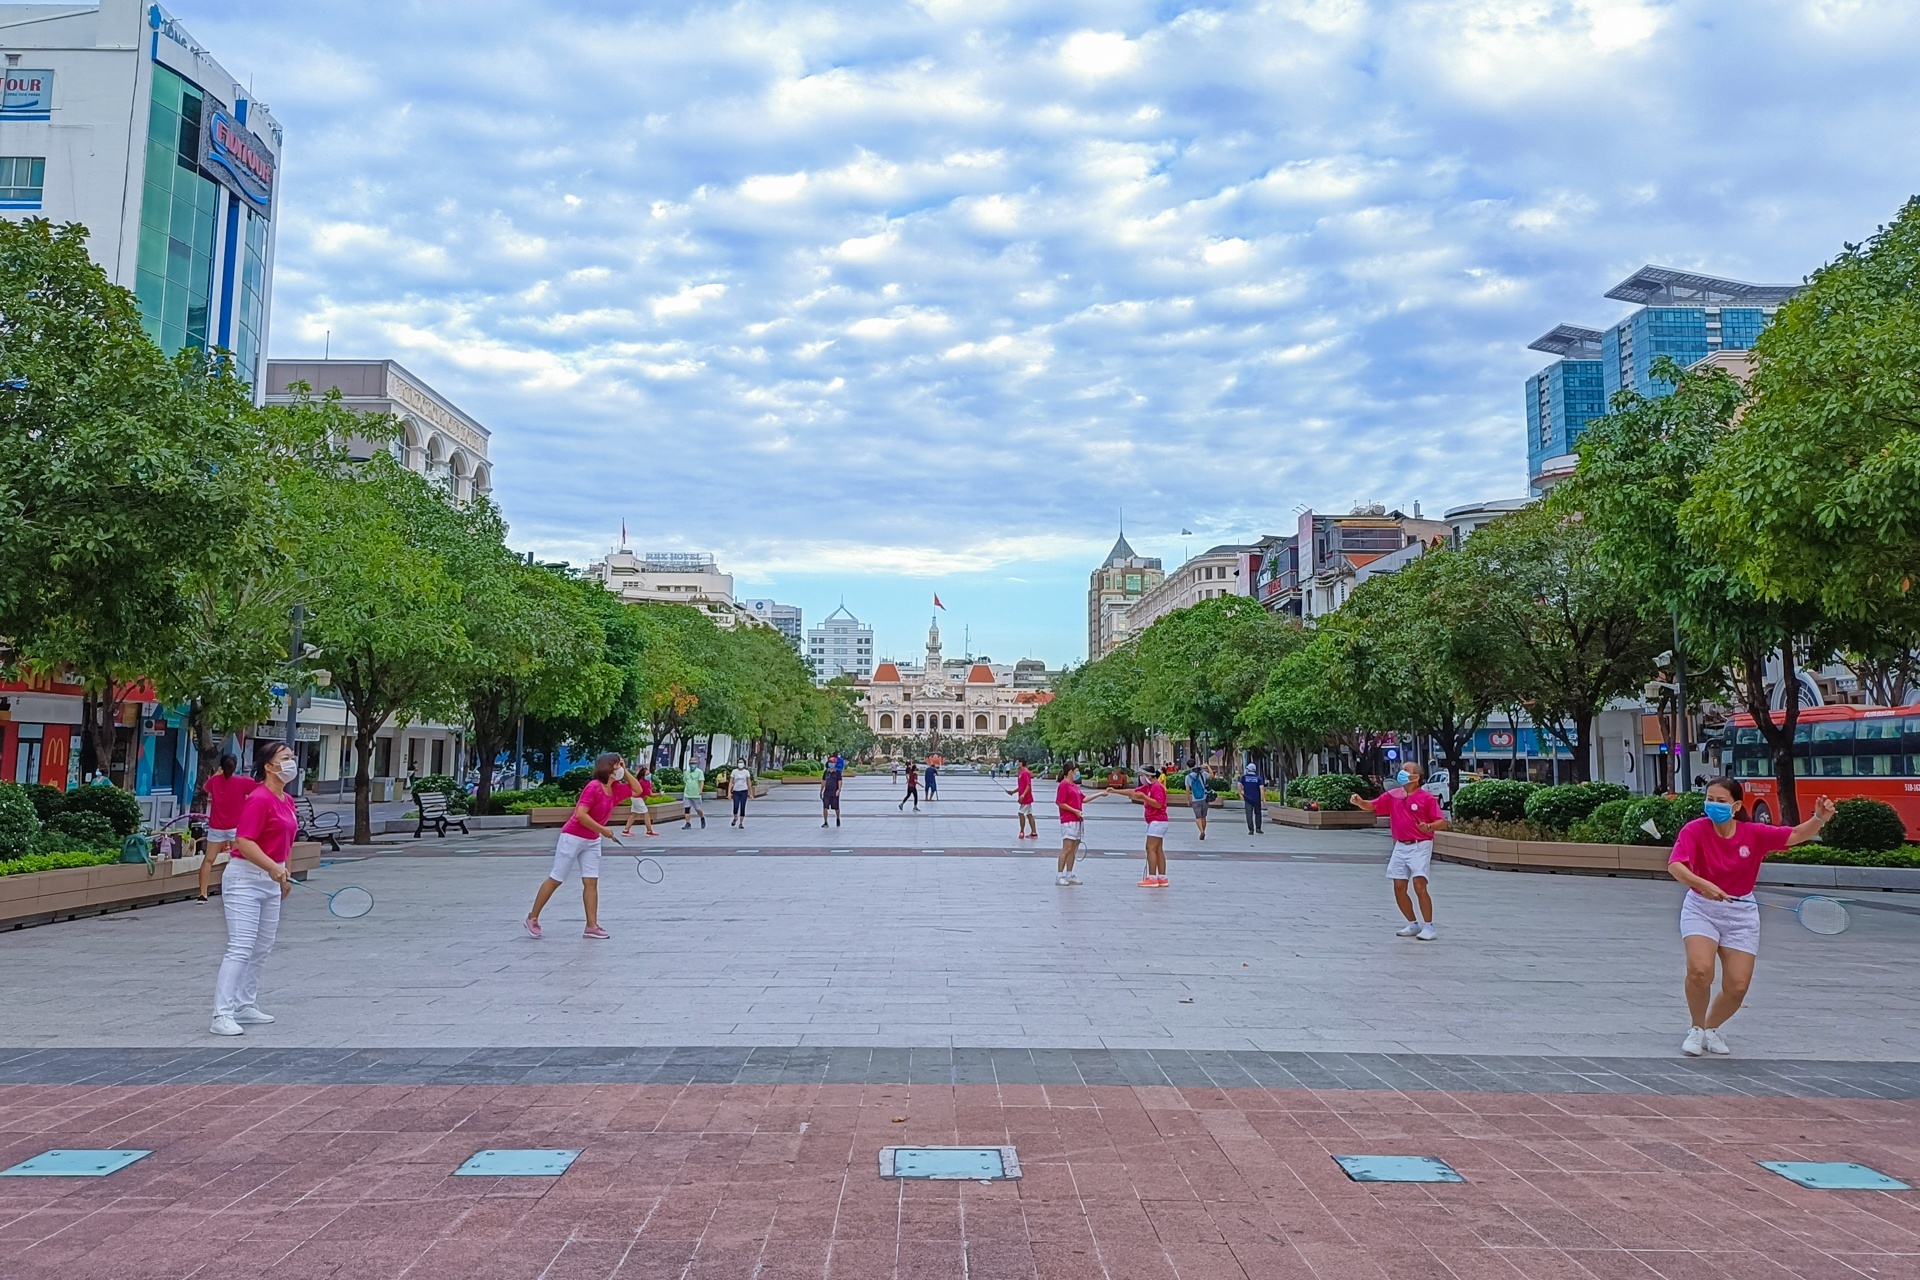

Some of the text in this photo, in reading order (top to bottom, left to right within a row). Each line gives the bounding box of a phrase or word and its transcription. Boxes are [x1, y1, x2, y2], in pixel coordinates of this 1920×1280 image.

[646, 553, 703, 561] REX HOTEL
[1904, 783, 1920, 791] 51B-16
